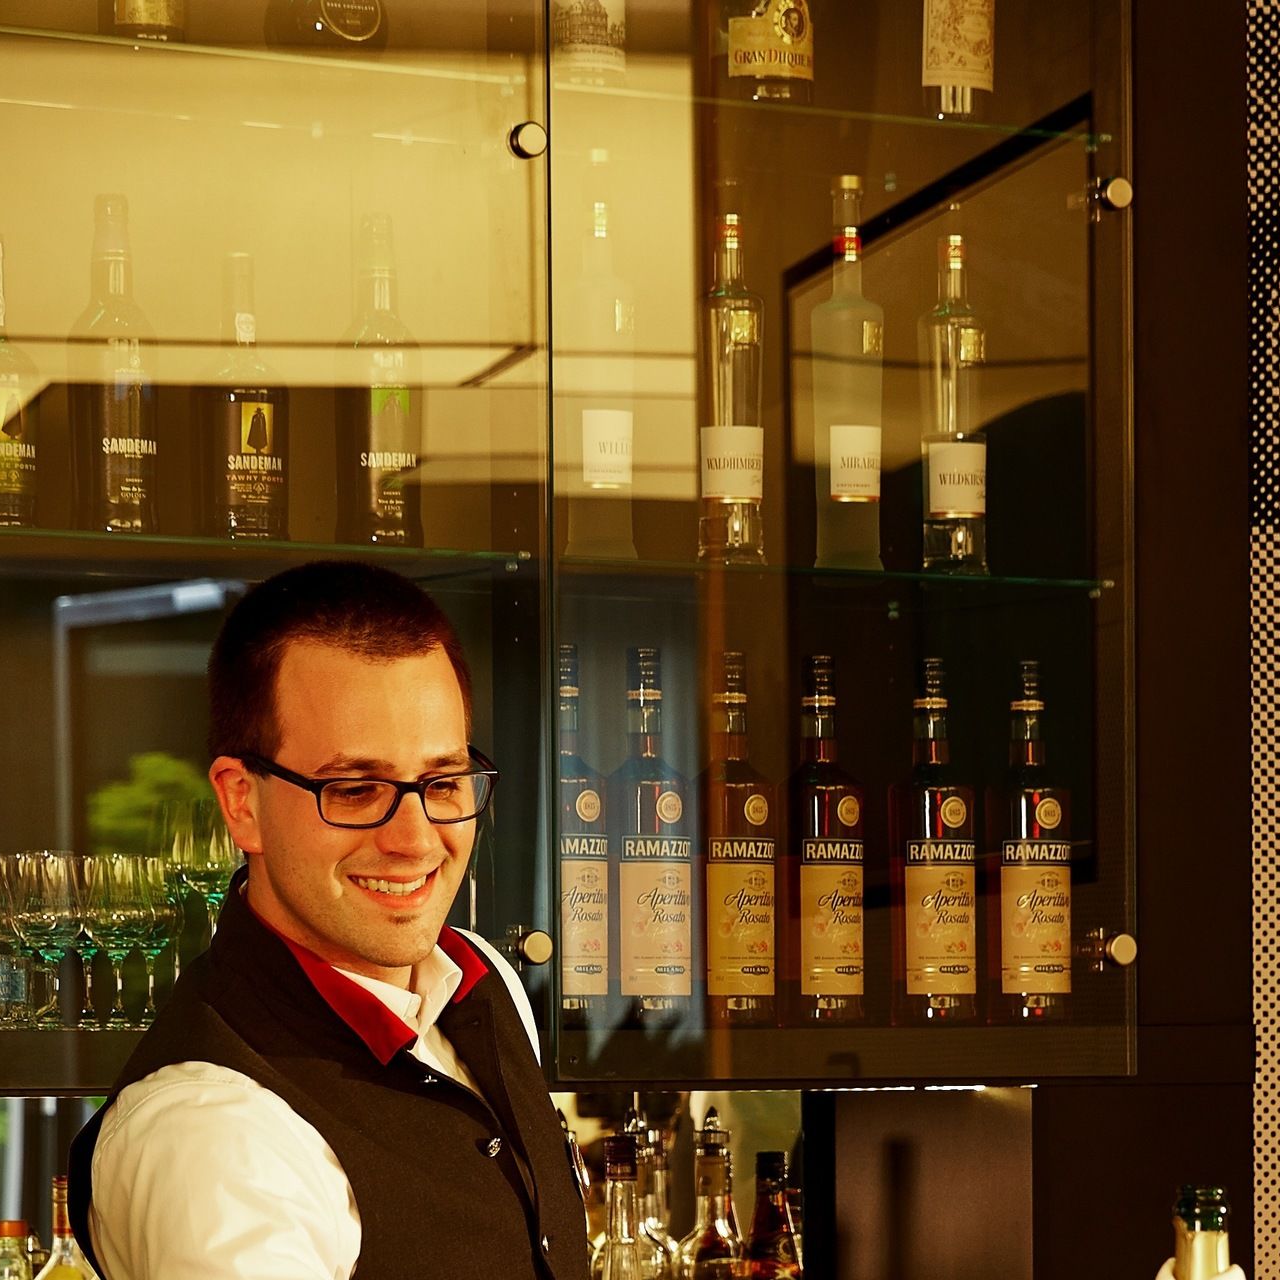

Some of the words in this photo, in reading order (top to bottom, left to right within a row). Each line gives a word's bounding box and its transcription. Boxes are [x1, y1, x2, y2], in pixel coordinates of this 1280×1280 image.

[734, 49, 766, 65] GRAN
[102, 437, 157, 455] SANDEMAN
[227, 454, 282, 471] SANDEMAN
[360, 452, 417, 468] SANDEMAN
[652, 908, 686, 924] Rosato
[936, 910, 970, 925] Rosato
[1031, 910, 1065, 925] Rosato
